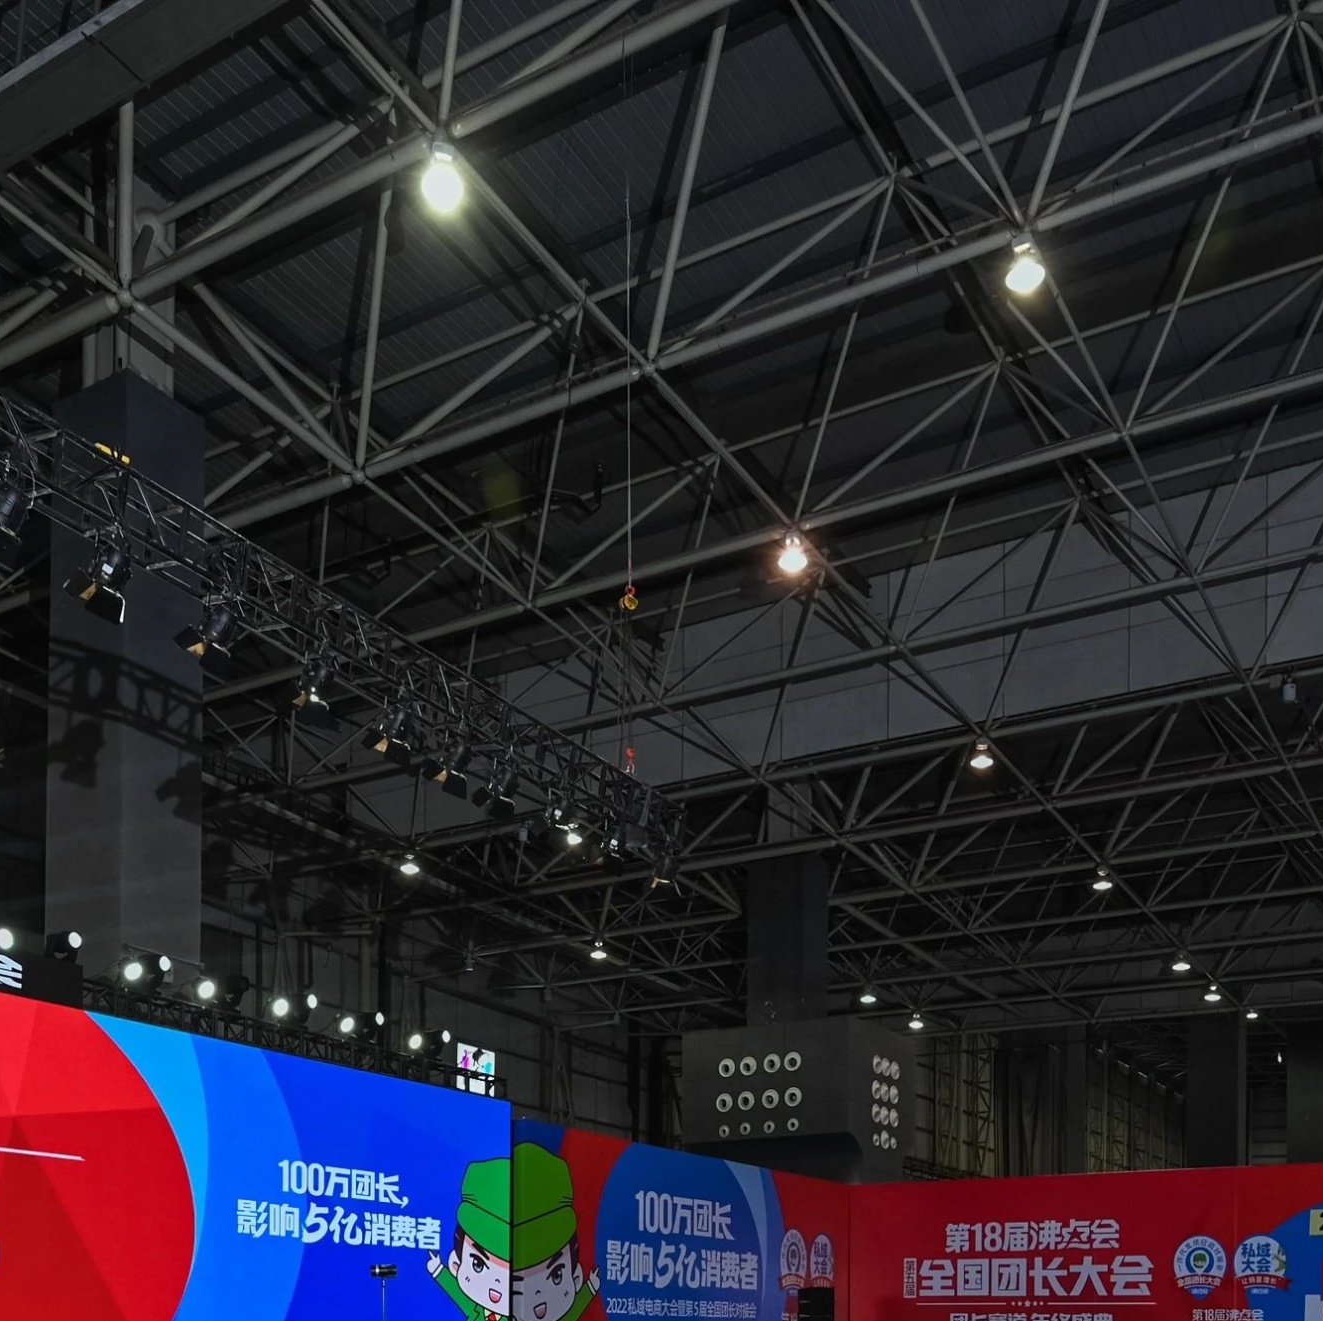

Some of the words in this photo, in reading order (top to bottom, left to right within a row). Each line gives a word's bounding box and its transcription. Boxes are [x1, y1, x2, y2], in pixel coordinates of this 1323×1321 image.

[236, 1197, 442, 1251] 影响5亿消费者
[634, 1189, 734, 1242] 100万团长
[945, 1219, 1120, 1254] 第18届沸点会
[1241, 1242, 1271, 1258] 私域
[606, 1237, 758, 1292] 影响5亿消费者
[904, 1258, 917, 1297] 第五届
[918, 1254, 1155, 1298] 全国团长大会
[1241, 1258, 1271, 1273] 大会
[1192, 1308, 1265, 1321] 第18届沸点会
